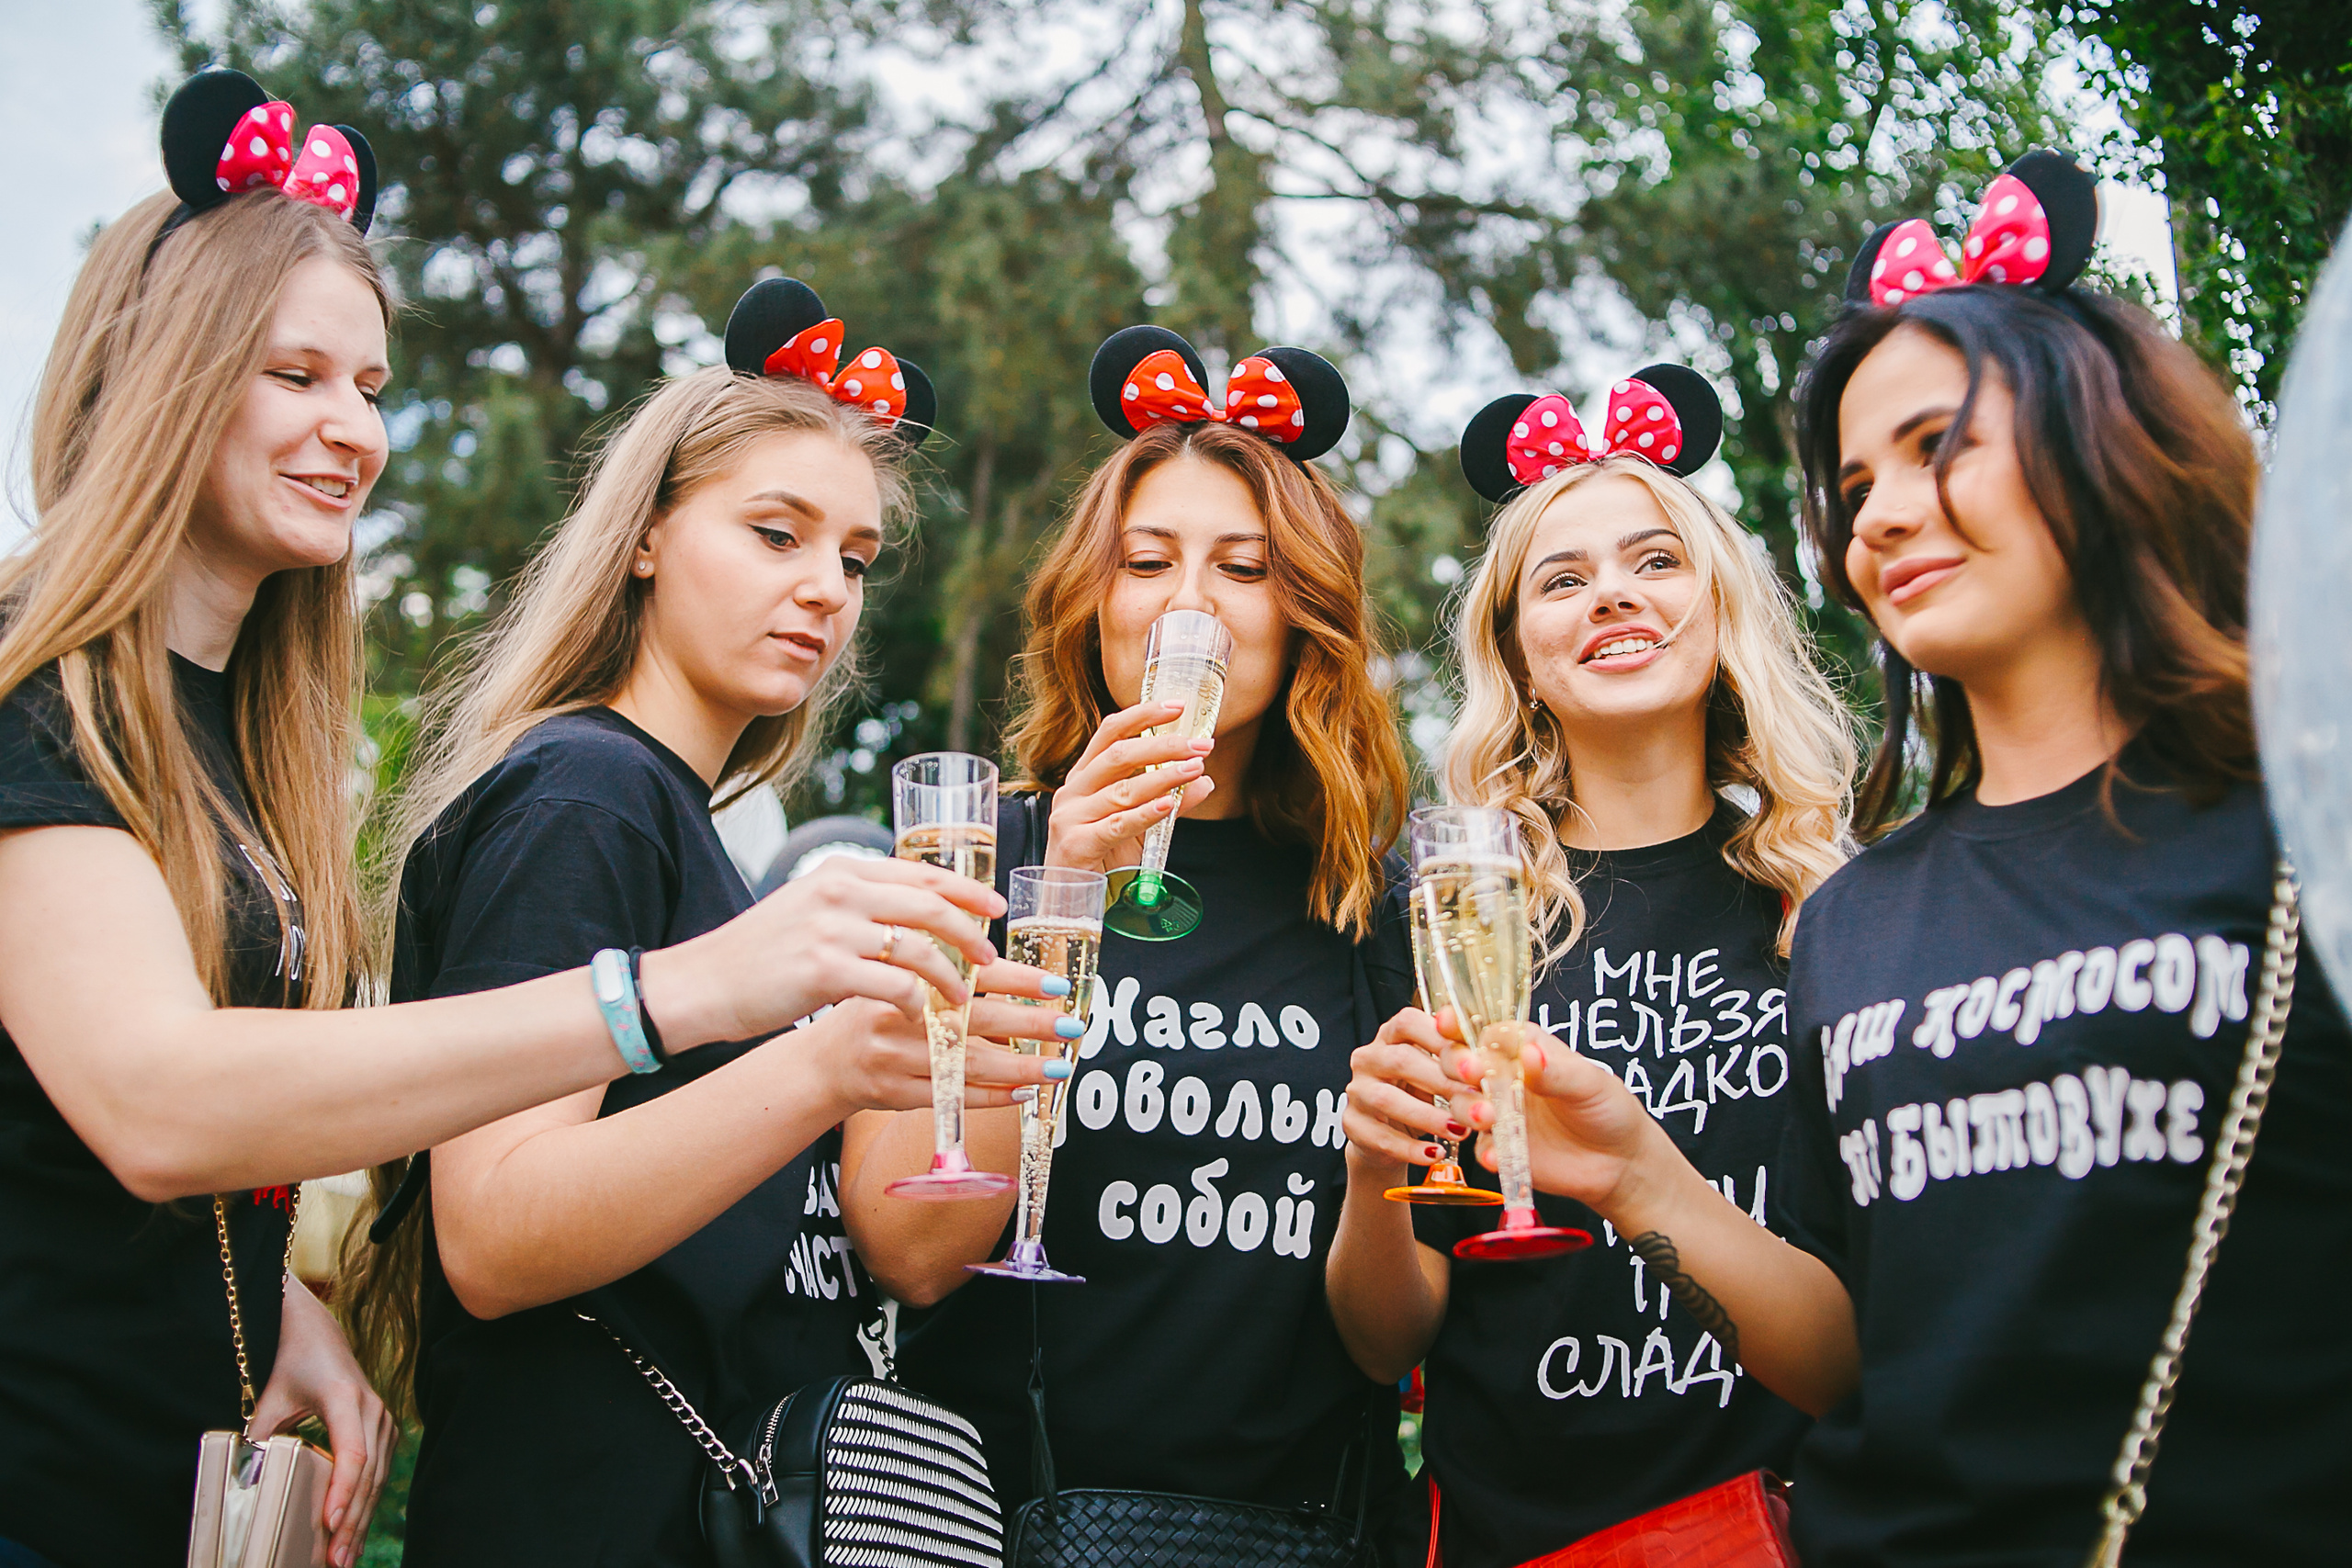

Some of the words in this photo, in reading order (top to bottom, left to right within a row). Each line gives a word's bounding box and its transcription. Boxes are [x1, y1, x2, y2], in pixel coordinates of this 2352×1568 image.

[1079, 974, 1320, 1059] Нагло
[1593, 946, 1724, 1008] МНЕ
[1539, 987, 1788, 1059] НЕЛЬЗЯ
[1053, 1059, 1347, 1149] овольн
[1582, 1043, 1790, 1135] АДКО
[1098, 1157, 1316, 1259] собой
[1536, 1326, 1743, 1409] СЛАД
